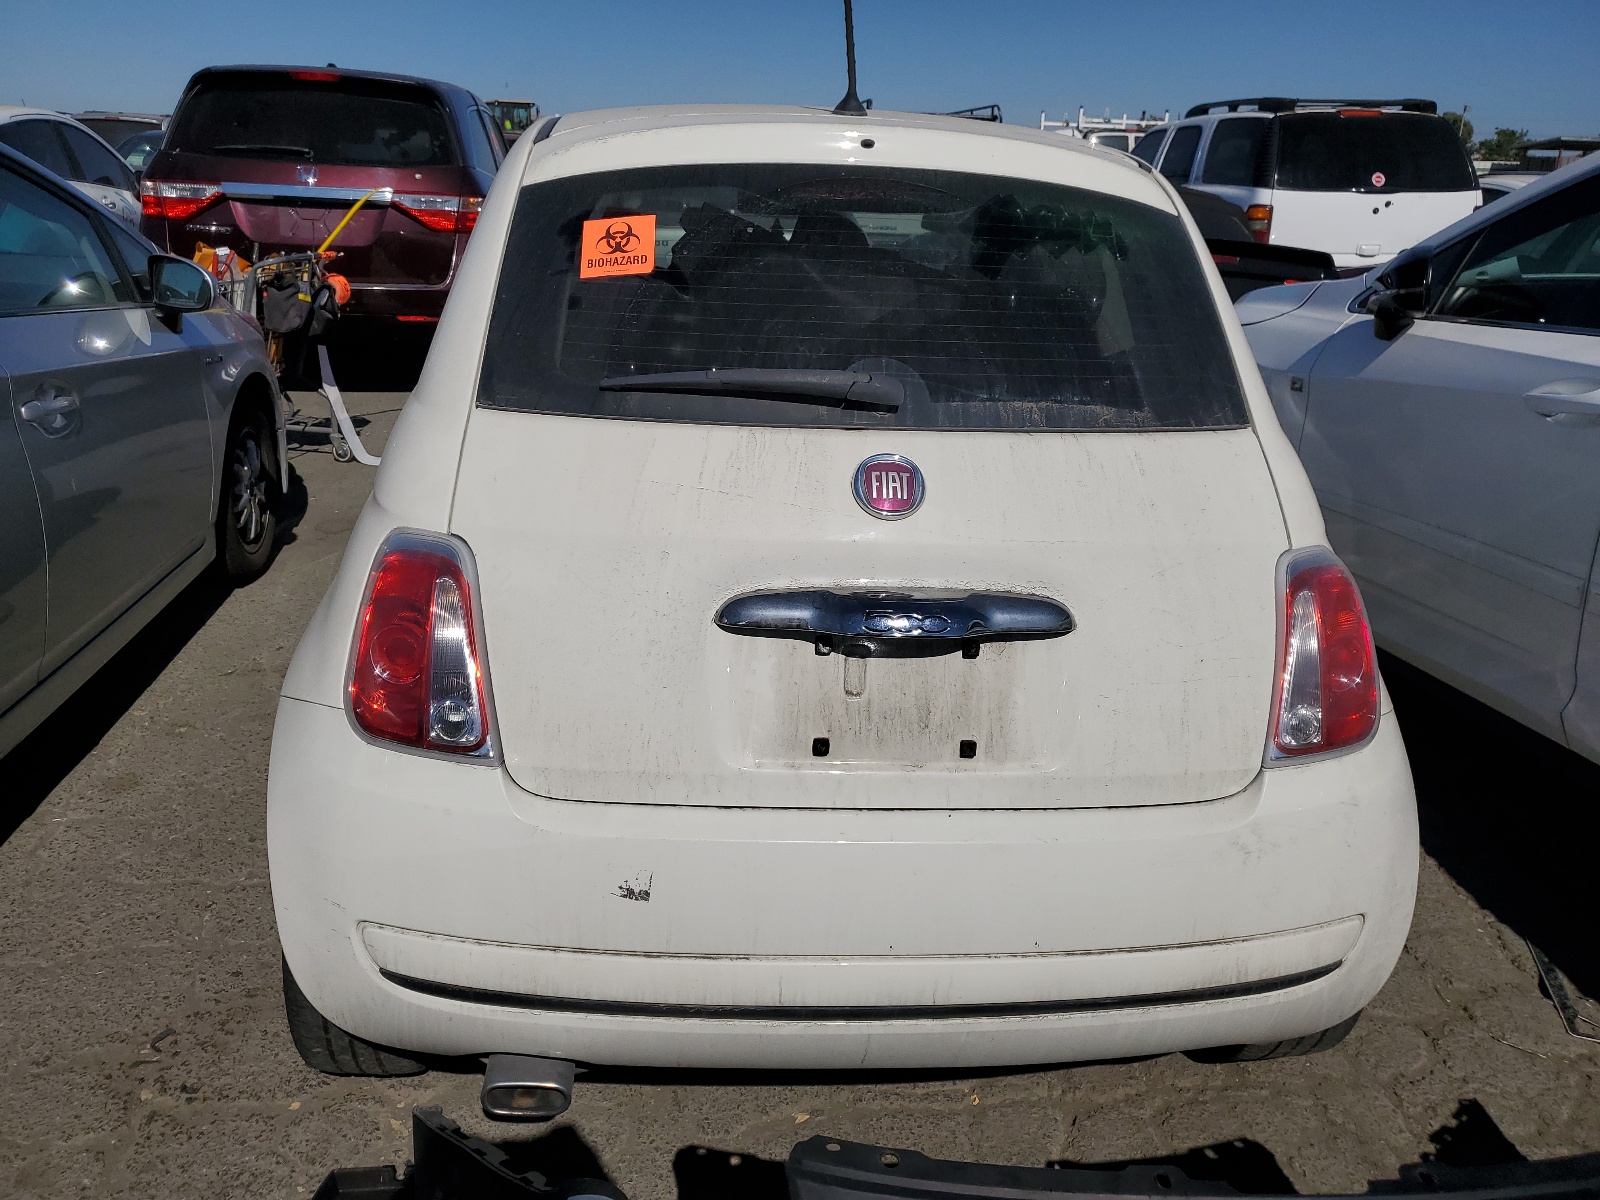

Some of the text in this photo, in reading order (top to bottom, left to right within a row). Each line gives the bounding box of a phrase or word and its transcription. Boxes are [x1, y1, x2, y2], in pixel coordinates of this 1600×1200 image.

[587, 254, 648, 269] BIOHAZARD
[871, 471, 910, 500] FIAT
[862, 609, 951, 635] 500
